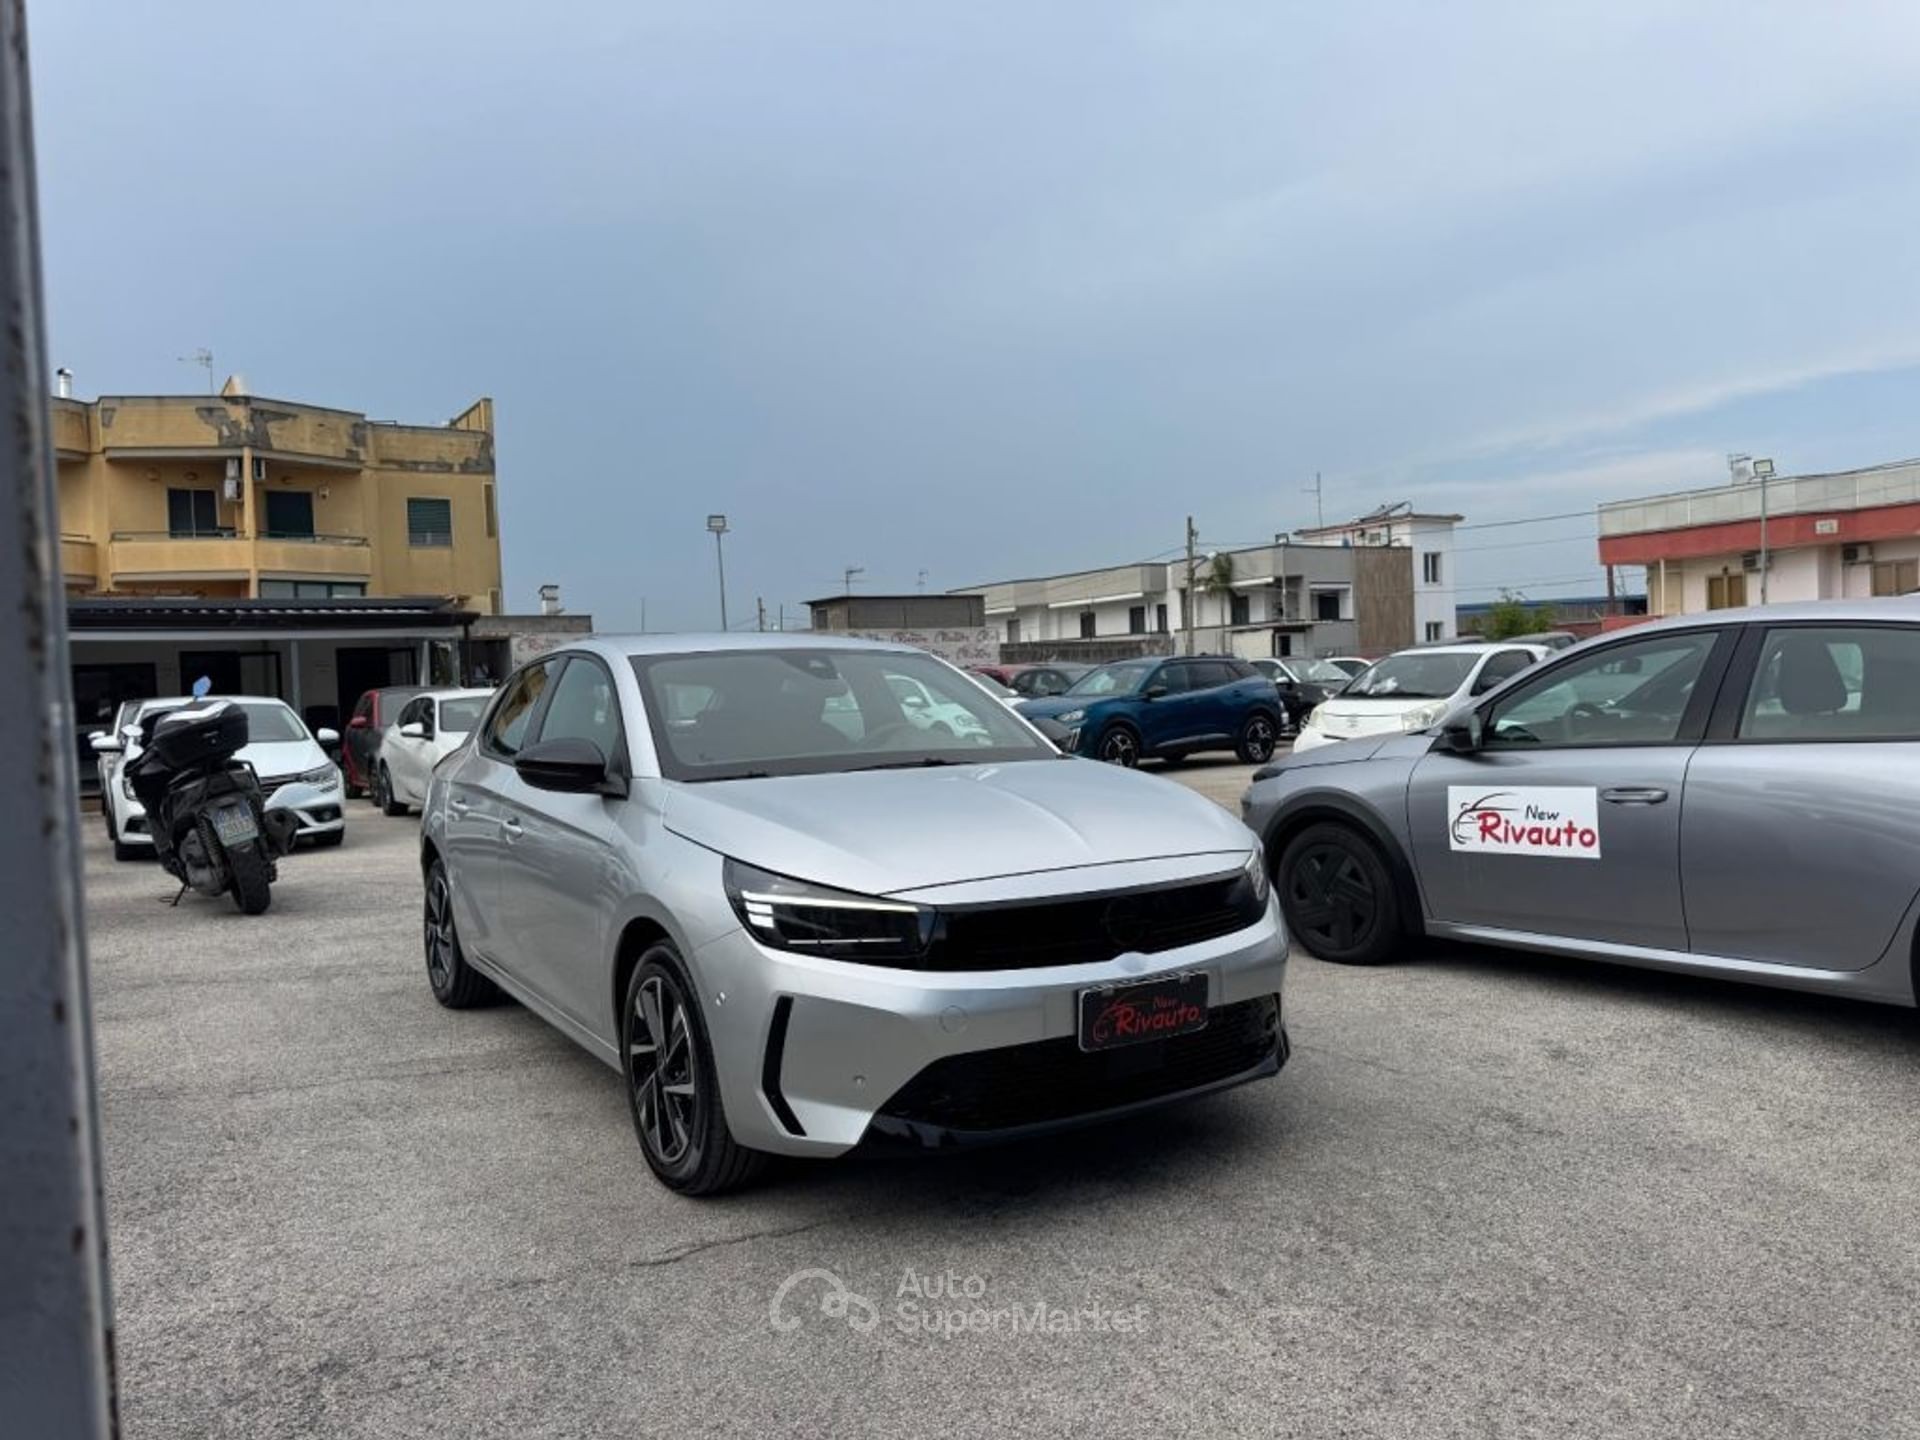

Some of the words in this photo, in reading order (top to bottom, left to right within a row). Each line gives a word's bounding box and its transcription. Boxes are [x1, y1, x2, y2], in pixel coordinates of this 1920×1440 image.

[1525, 805, 1560, 821] New
[1477, 812, 1596, 848] Rivauto
[1115, 1004, 1201, 1036] Rivauto
